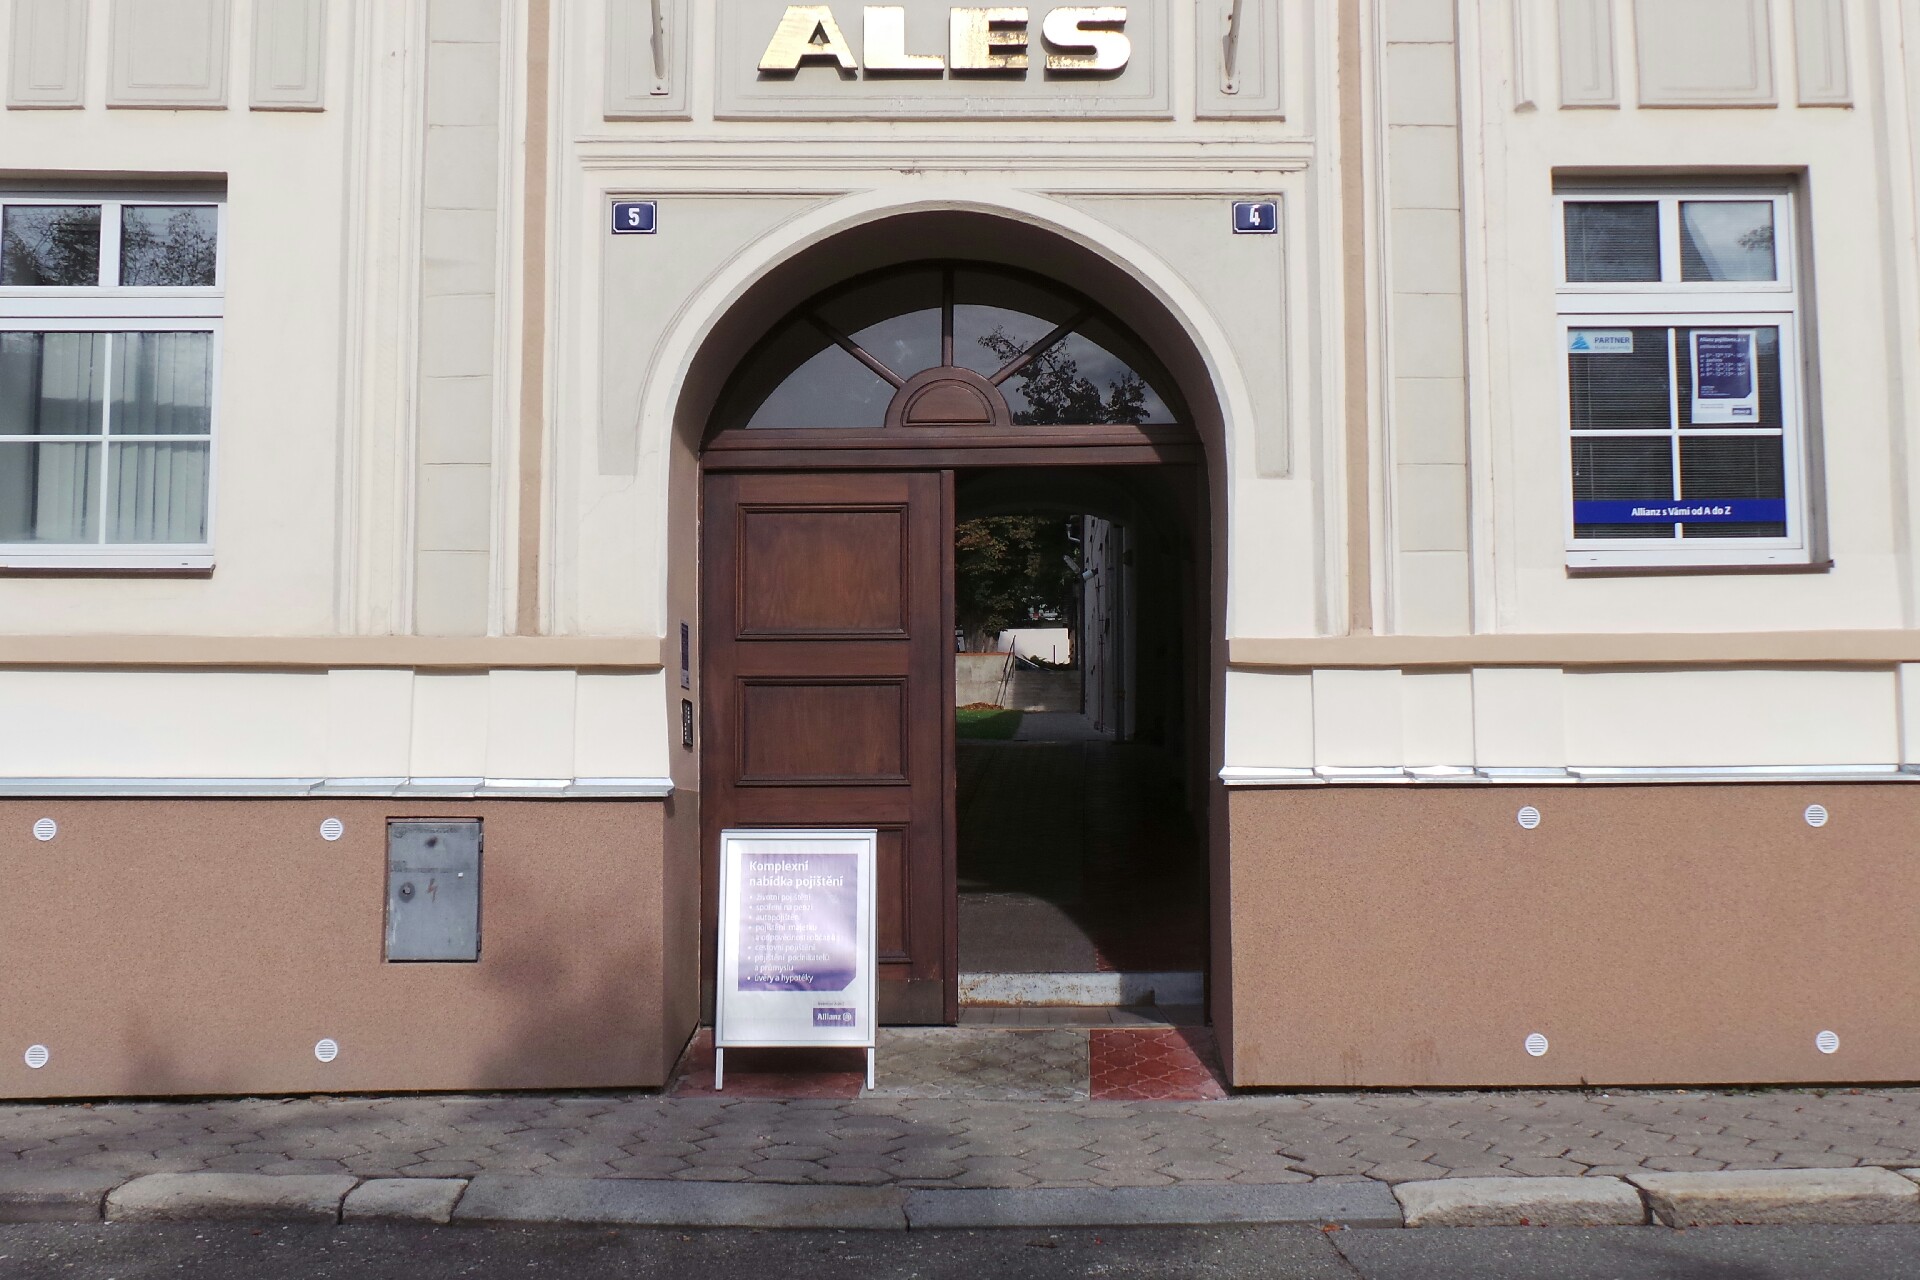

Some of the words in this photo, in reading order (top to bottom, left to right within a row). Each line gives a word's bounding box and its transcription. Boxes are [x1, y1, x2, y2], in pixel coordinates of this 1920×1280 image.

[756, 5, 1131, 73] ALES
[628, 207, 640, 226] 5
[1249, 206, 1261, 226] 4
[1594, 336, 1631, 344] PARTNER
[1631, 507, 1661, 516] Allianz
[1667, 506, 1691, 516] Vámi
[1691, 506, 1703, 515] od
[1703, 506, 1711, 515] A
[1711, 506, 1724, 515] do
[1724, 506, 1732, 515] Z
[749, 860, 809, 874] Komplexní
[749, 875, 793, 887] nabídka
[795, 875, 844, 889] pojištění
[754, 974, 774, 983] úvěry
[780, 973, 814, 983] hypotéky
[817, 1012, 842, 1021] Allianz
